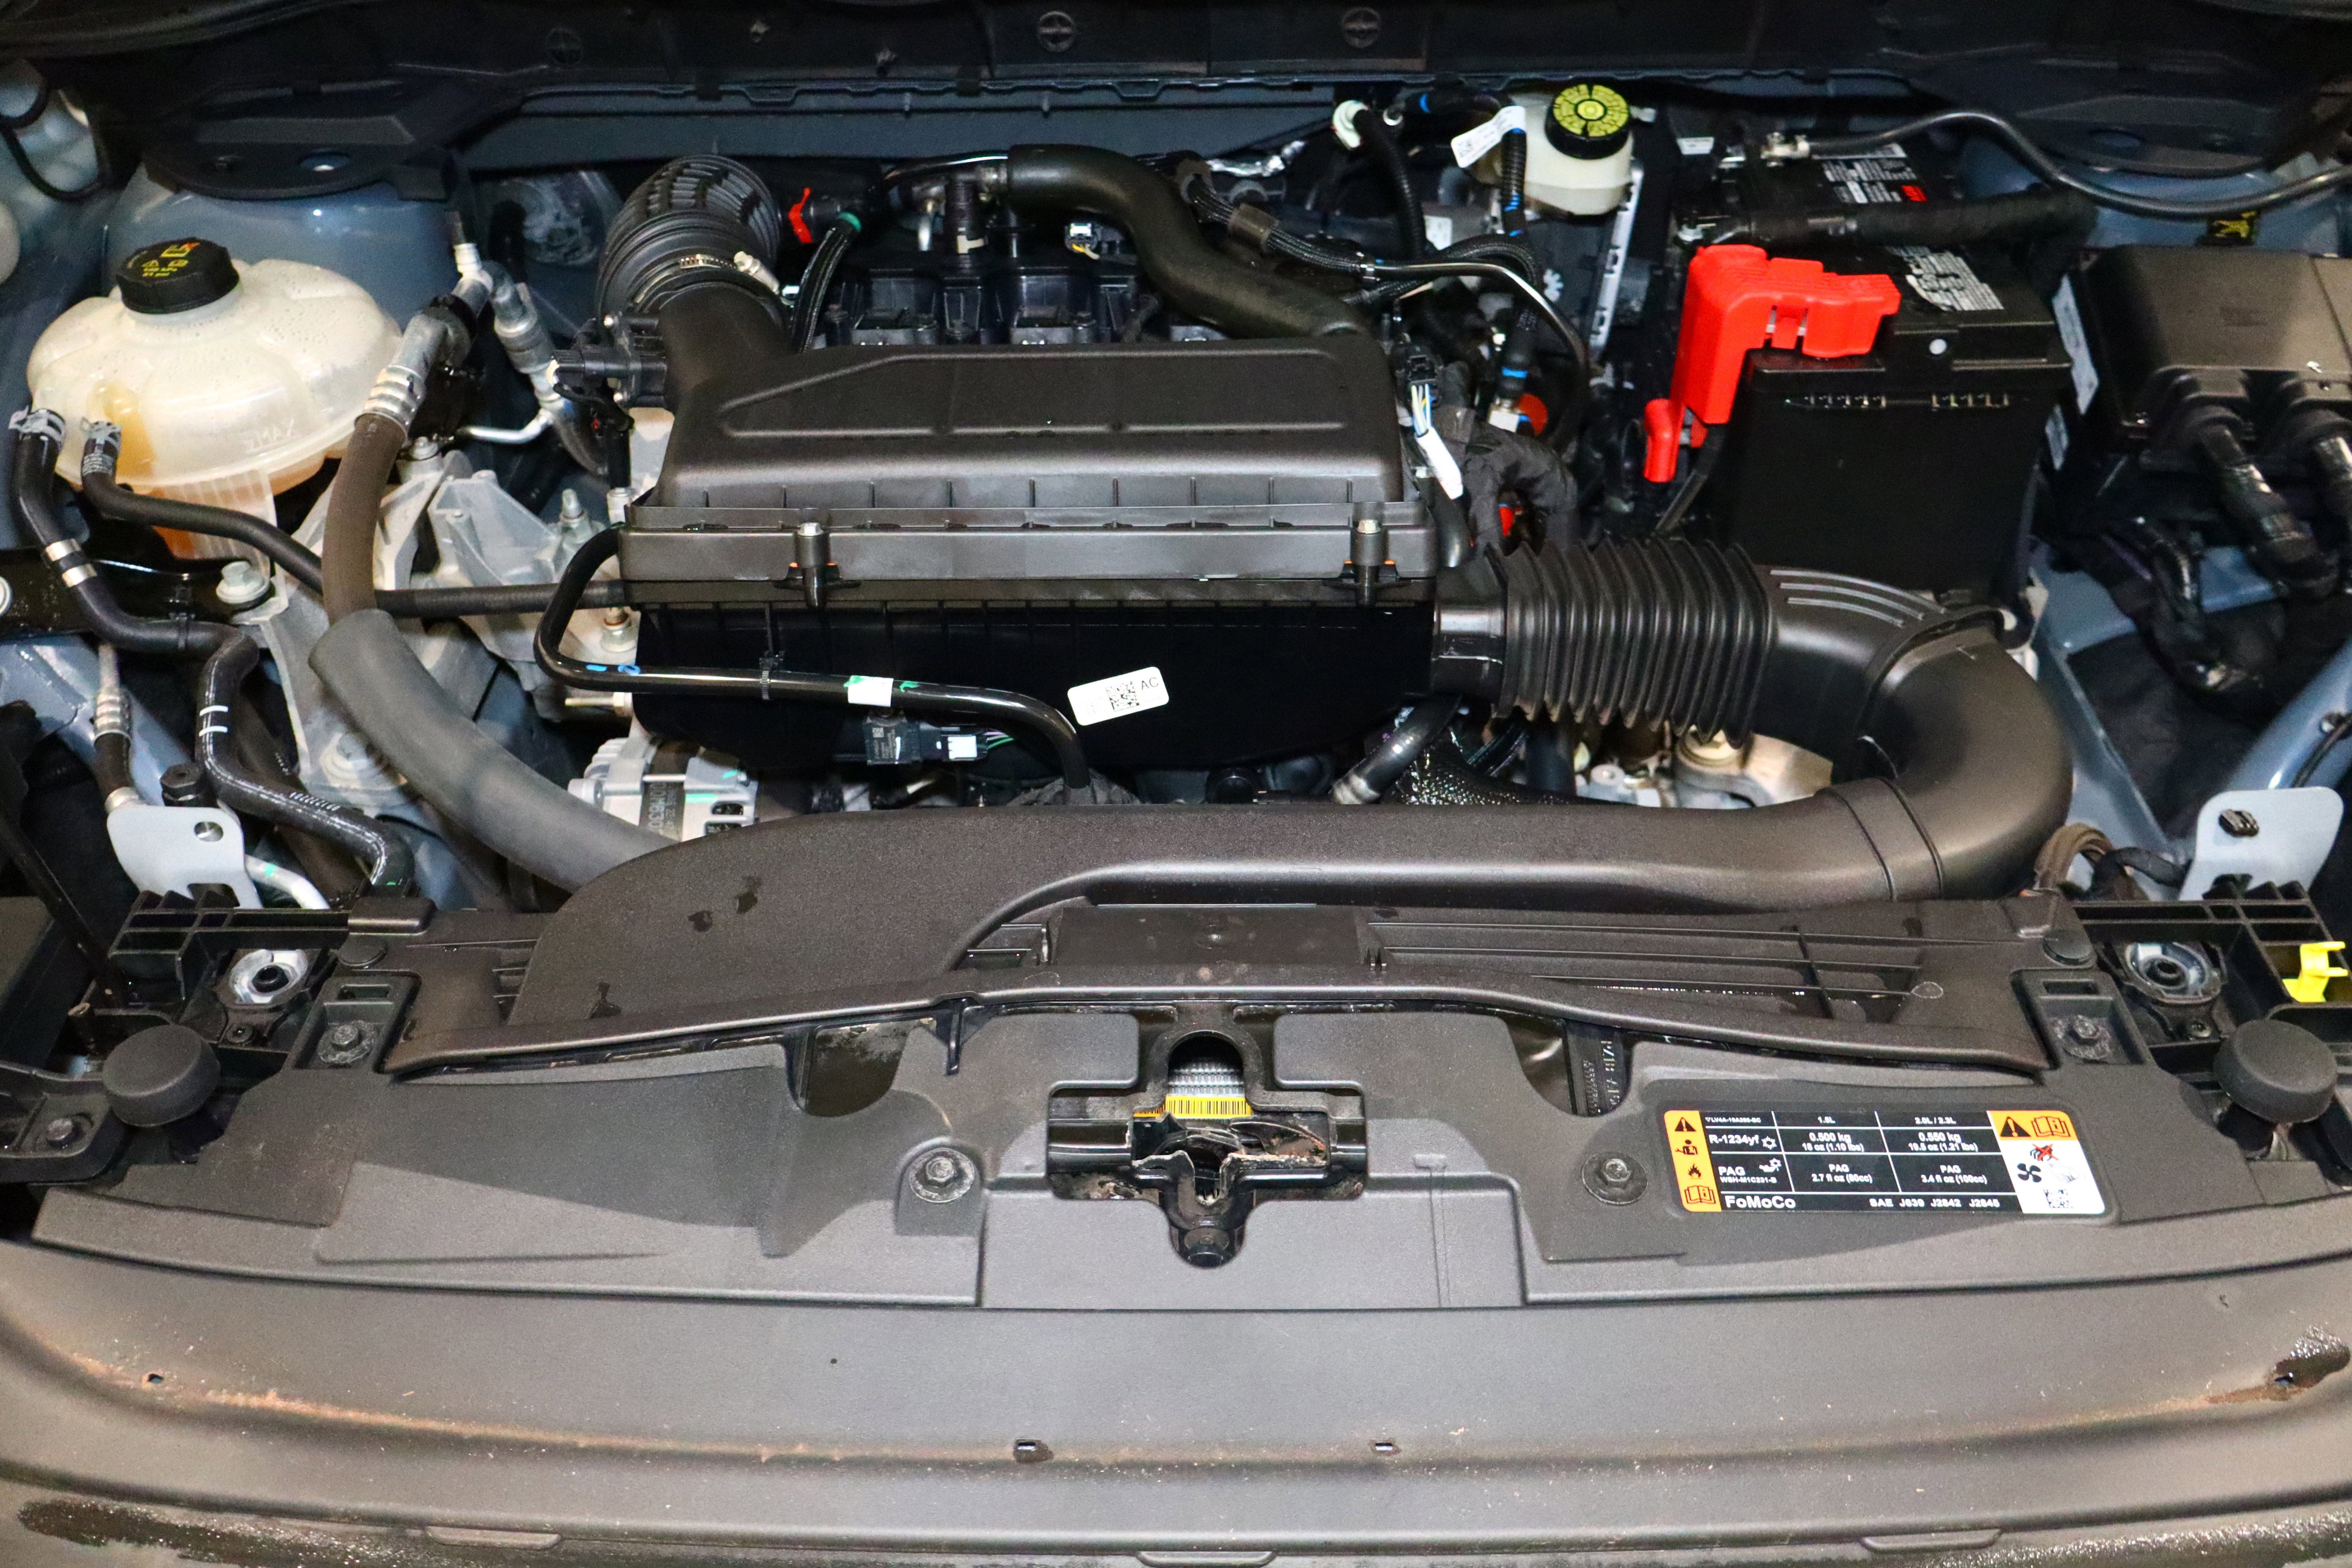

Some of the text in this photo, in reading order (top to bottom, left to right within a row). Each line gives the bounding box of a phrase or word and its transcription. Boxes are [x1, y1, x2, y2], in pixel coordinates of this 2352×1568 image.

[1141, 677, 1158, 690] AC
[1708, 1134, 1759, 1146] R-1234yf
[1809, 1132, 1851, 1143] 0.500 kg
[1918, 1132, 1961, 1143] 0.550 kg
[1802, 1143, 1813, 1151] 18
[1826, 1143, 1846, 1152] (1.10
[1847, 1143, 1864, 1152] lbs)
[1908, 1143, 1927, 1151] 19.5
[1940, 1143, 1960, 1152] (1.21
[1961, 1143, 1978, 1152] lbs)
[1718, 1167, 1746, 1176] PAG
[1829, 1164, 1850, 1172] PAG
[1940, 1165, 1961, 1173] PAG
[1811, 1174, 1824, 1182] 2.7
[1826, 1174, 1833, 1182] fl
[1846, 1174, 1873, 1184] (80cc)
[1921, 1174, 1935, 1183] 3.4
[1936, 1174, 1942, 1183] fl
[1956, 1174, 1988, 1185] (100cc)
[1725, 1196, 1796, 1209] FoMoCo
[1869, 1198, 1894, 1207] SAE
